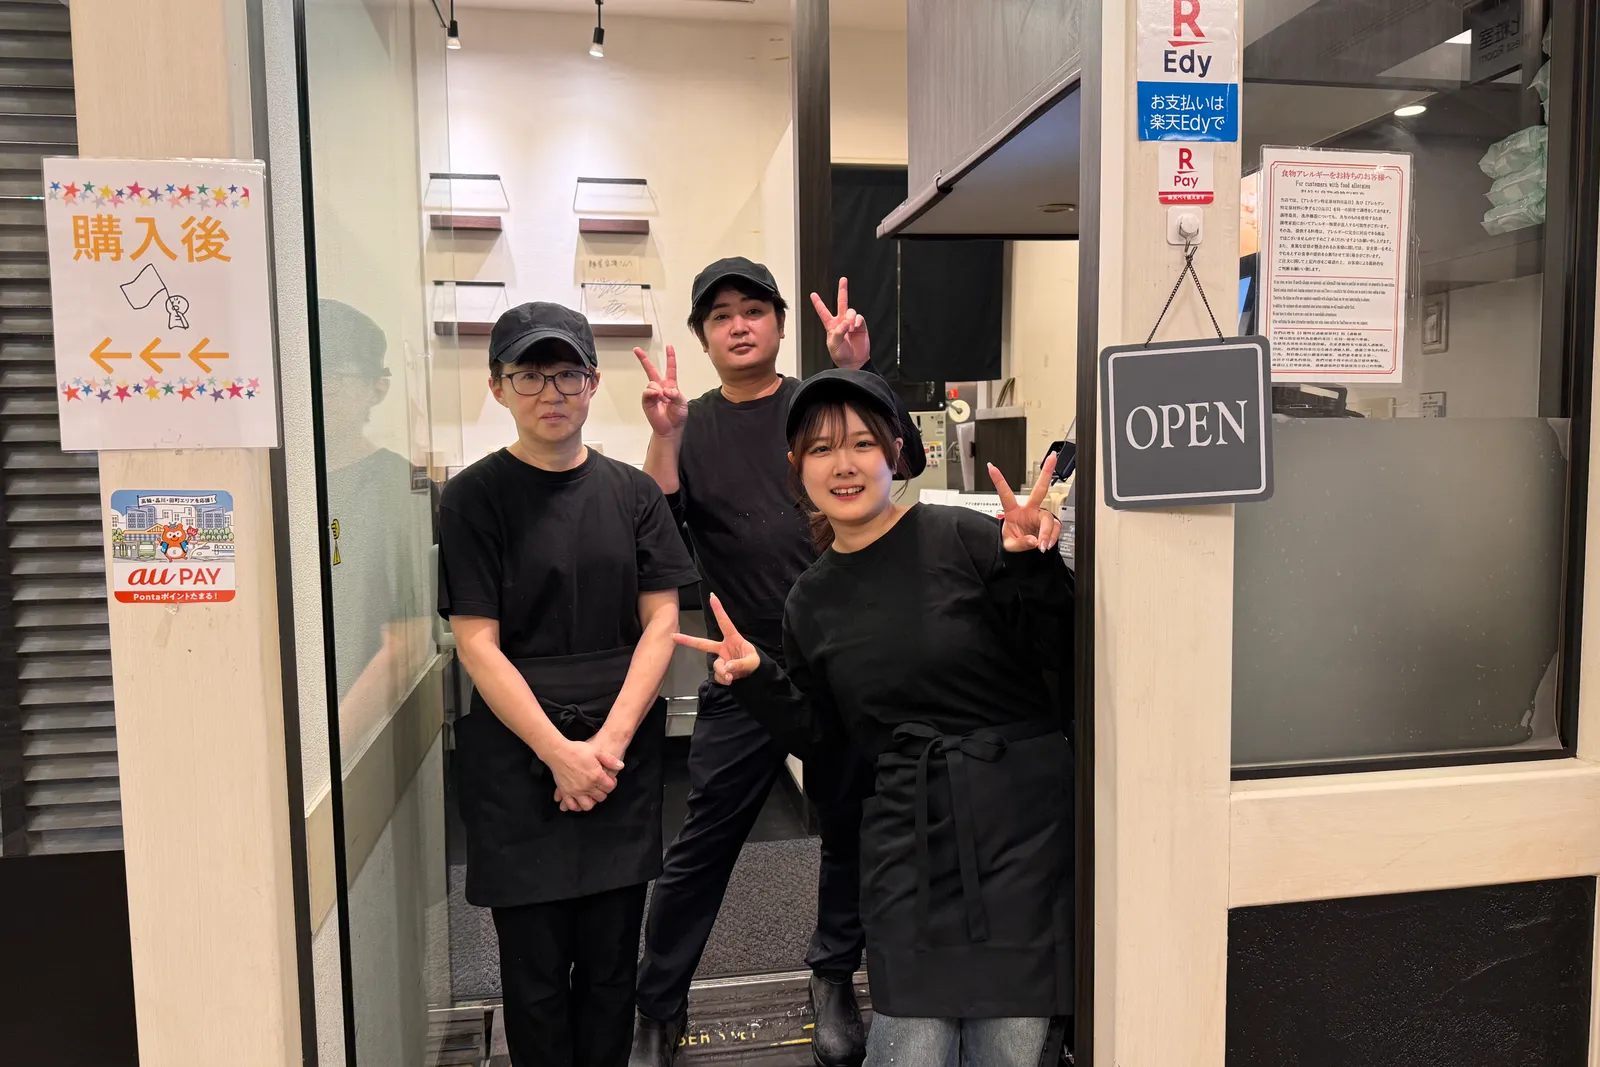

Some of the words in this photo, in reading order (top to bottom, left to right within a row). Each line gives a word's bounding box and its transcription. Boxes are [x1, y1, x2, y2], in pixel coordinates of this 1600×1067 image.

[1173, 0, 1206, 38] R
[1164, 49, 1212, 78] Edy
[1151, 94, 1225, 111] お支払いは
[1150, 114, 1226, 134] 楽天Edyで
[1179, 148, 1195, 169] R
[1173, 175, 1199, 189] Pay
[1281, 169, 1393, 181] 食物アレルギーをお持ちのお客様へ
[72, 213, 232, 263] 購入後
[1125, 400, 1248, 450] OPEN
[127, 568, 176, 586] au
[180, 567, 221, 585] PAY
[133, 592, 218, 601] Pontaポイントたまる！
